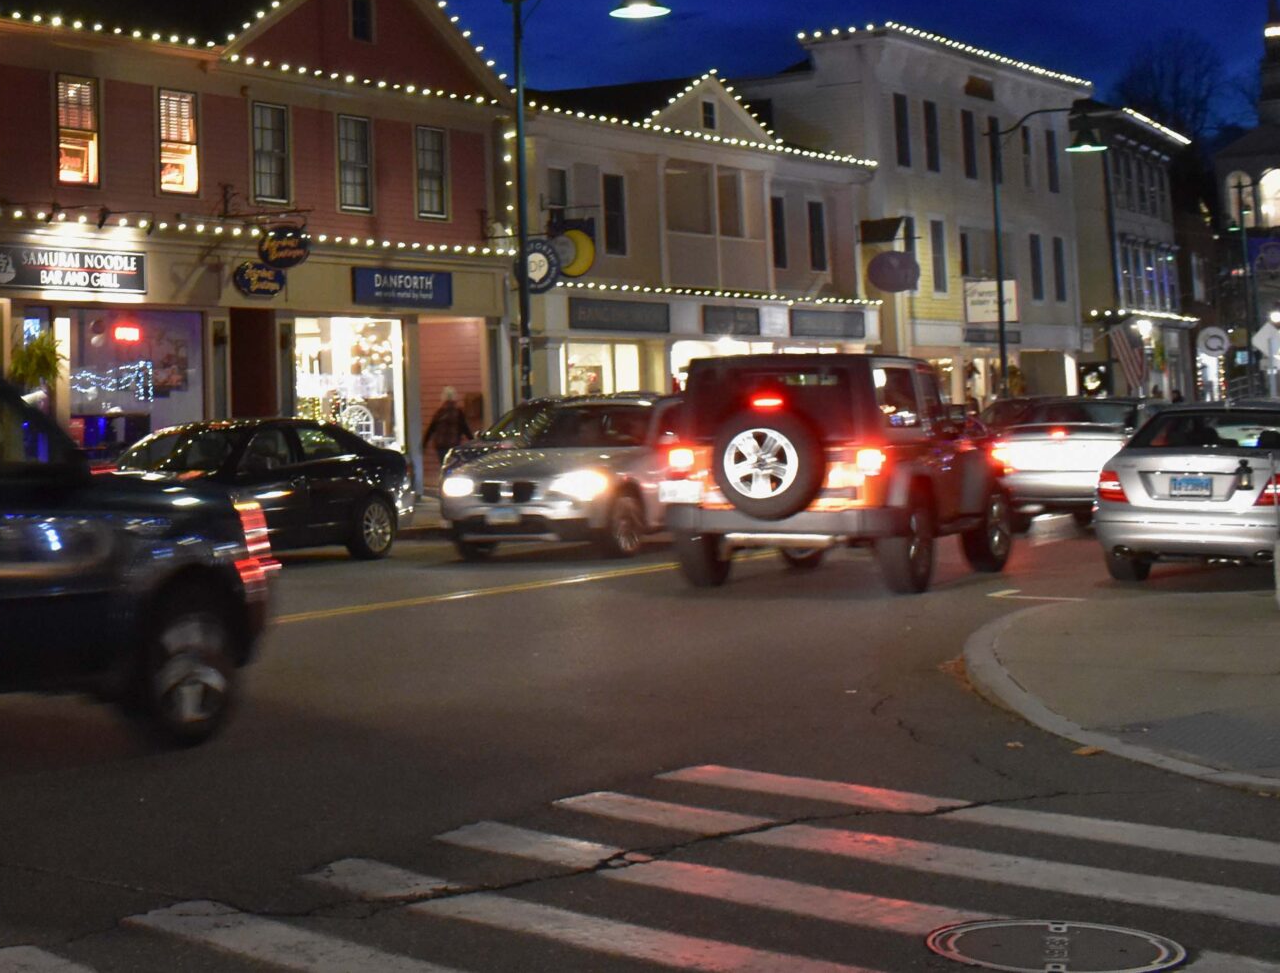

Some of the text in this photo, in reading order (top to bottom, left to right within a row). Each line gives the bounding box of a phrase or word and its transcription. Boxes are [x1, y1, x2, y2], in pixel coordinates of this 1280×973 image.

[21, 249, 138, 271] SAMURAI NOODLE
[40, 269, 121, 289] BAR AND GRILL
[373, 273, 433, 291] DANFORTH
